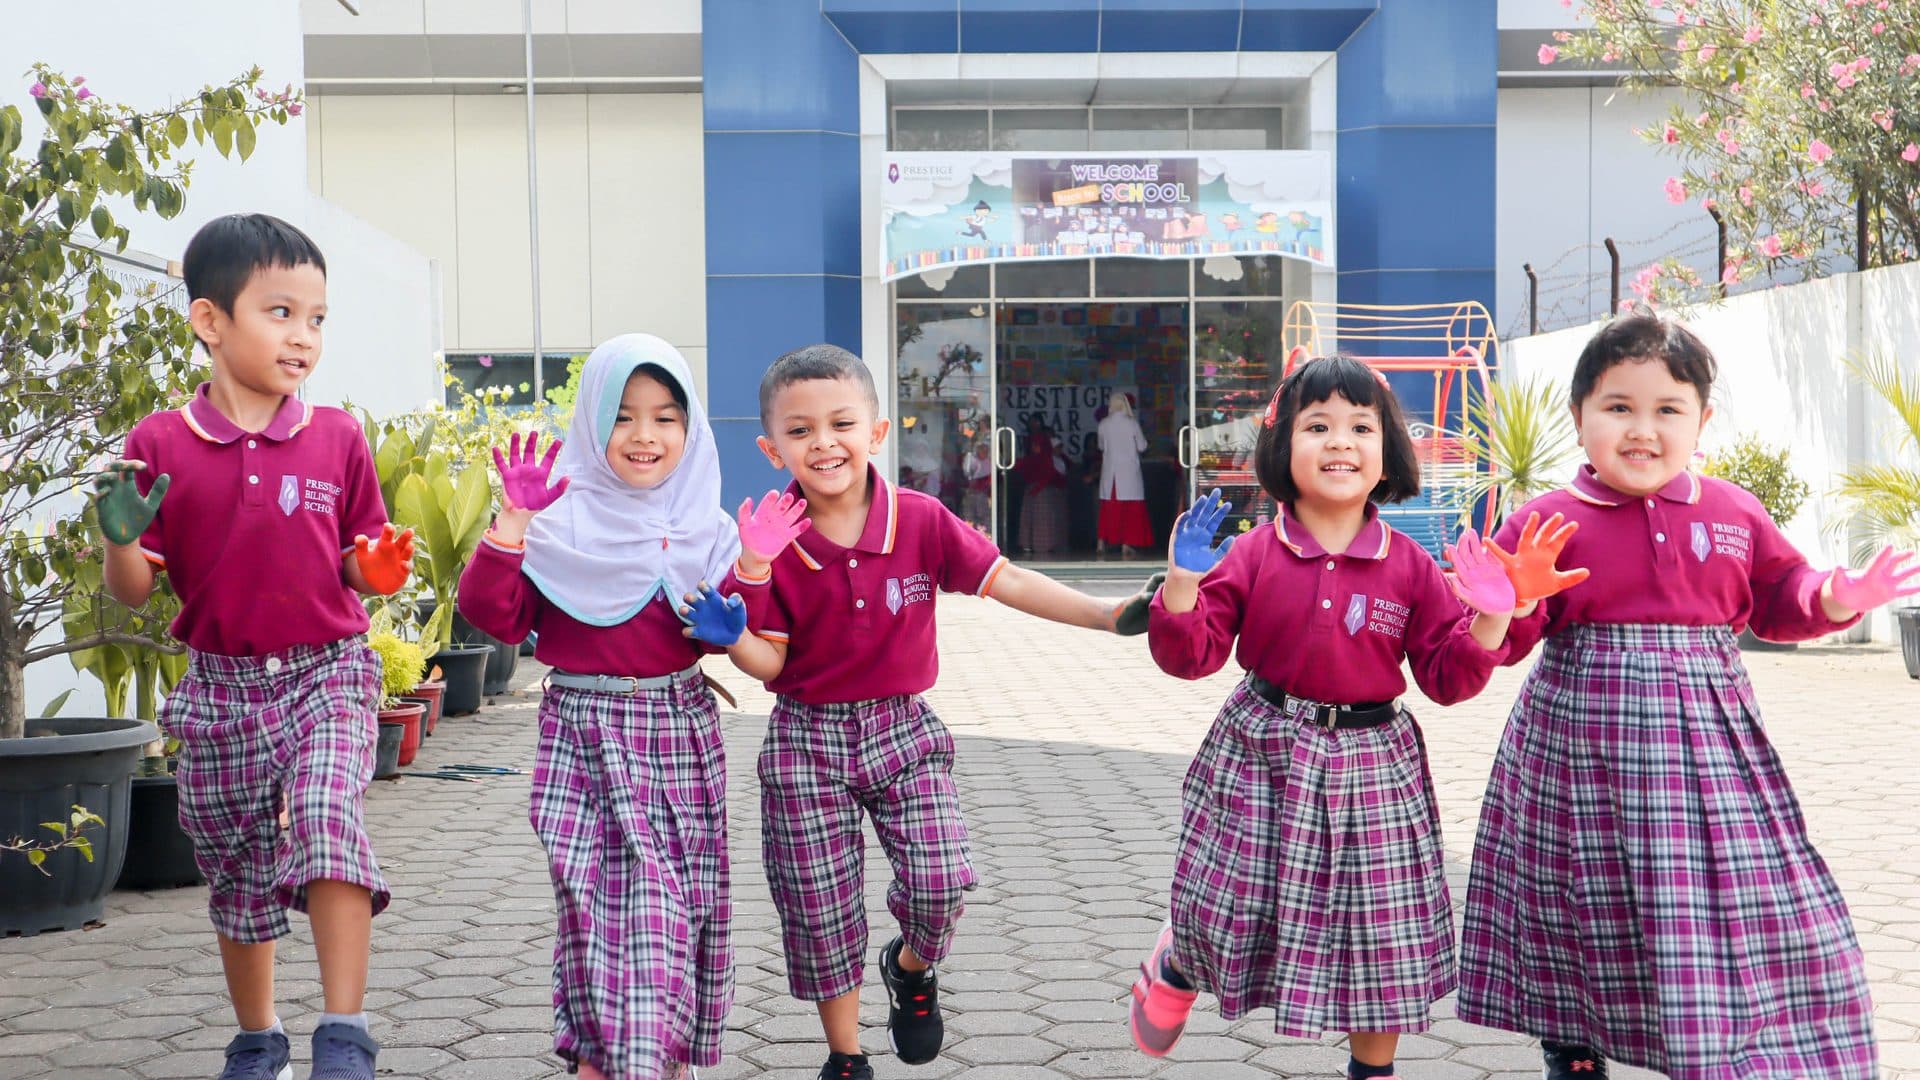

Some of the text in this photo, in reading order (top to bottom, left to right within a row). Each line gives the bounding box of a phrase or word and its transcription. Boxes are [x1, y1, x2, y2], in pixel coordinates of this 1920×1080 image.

[1071, 164, 1158, 181] WELCOME
[1101, 182, 1190, 203] SCHOOL
[1006, 386, 1113, 409] RESTIGE
[1716, 544, 1747, 561] SCHOOL
[904, 592, 930, 607] SHOOL
[1374, 597, 1411, 617] PRESTIGE
[1368, 621, 1401, 638] SCHOOL
